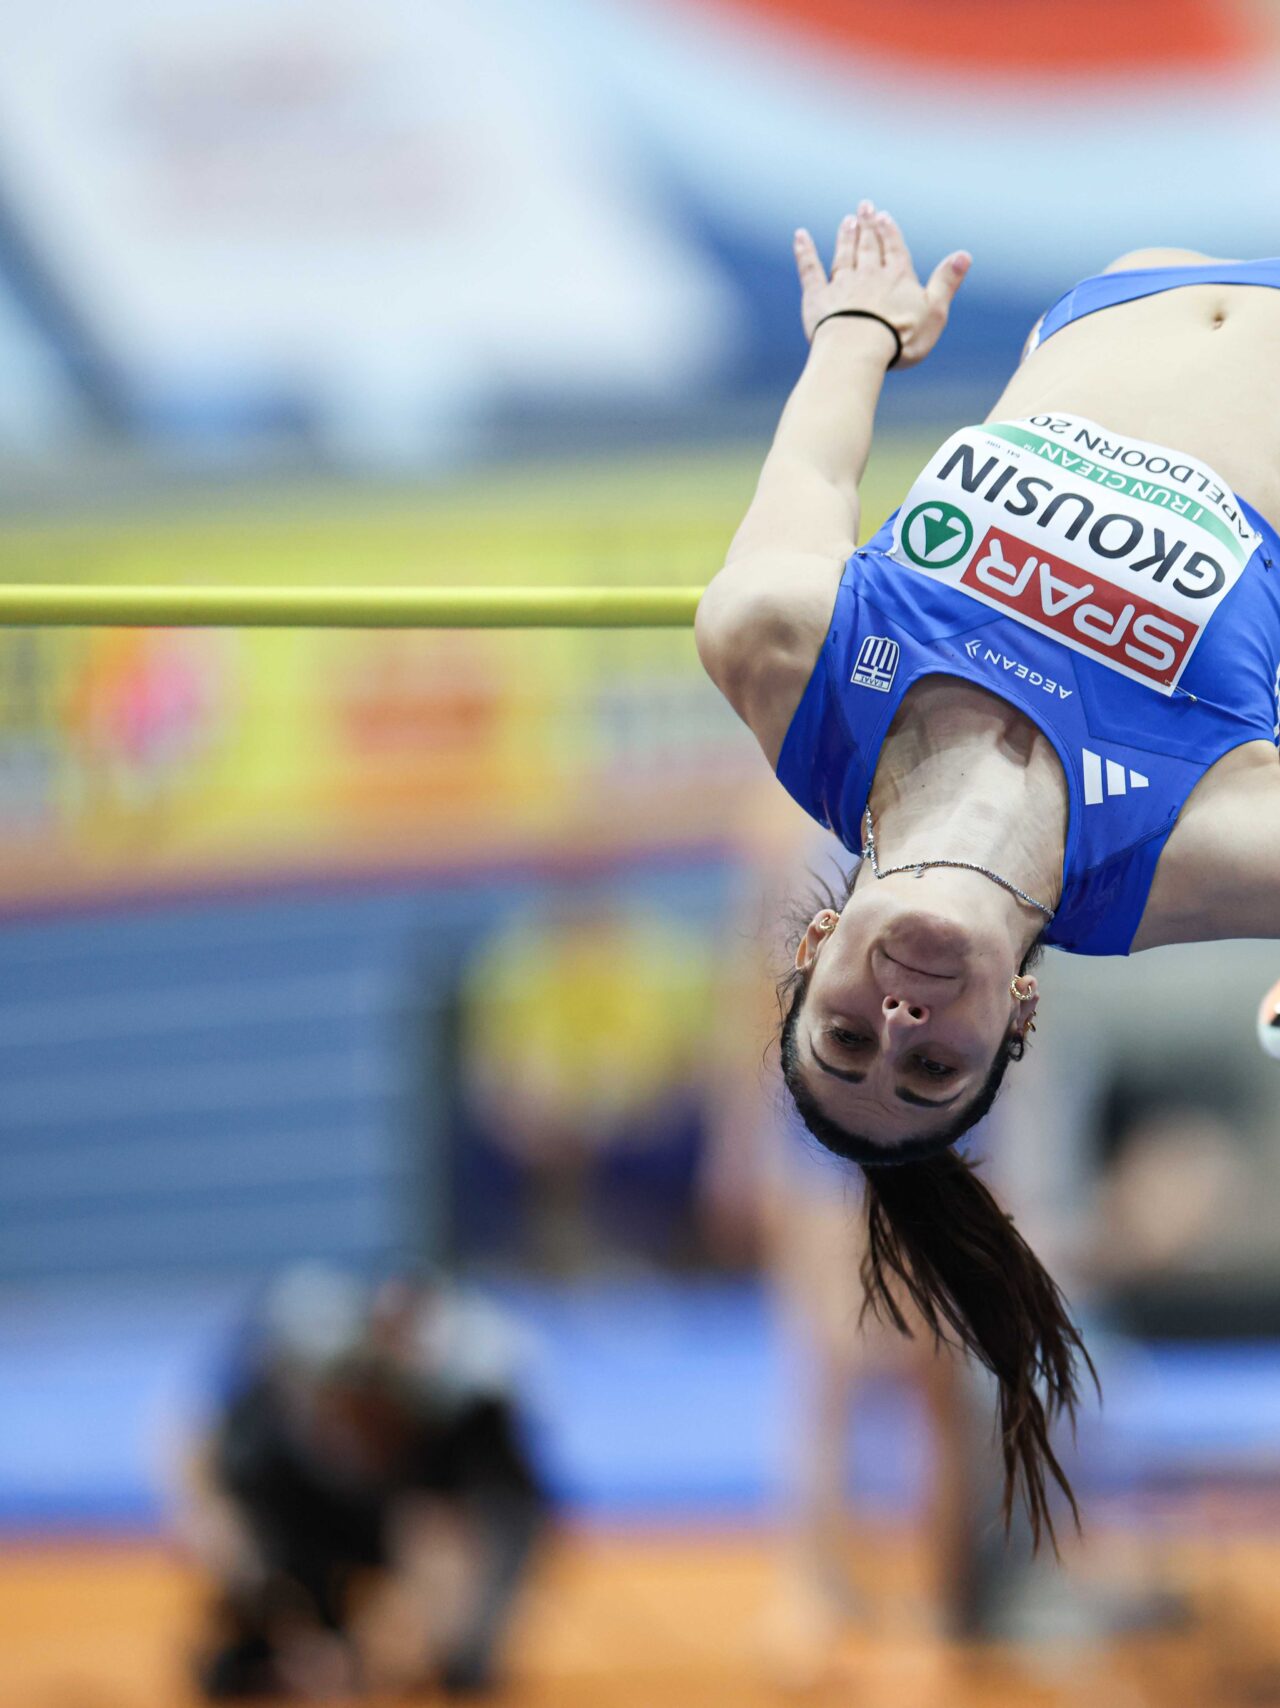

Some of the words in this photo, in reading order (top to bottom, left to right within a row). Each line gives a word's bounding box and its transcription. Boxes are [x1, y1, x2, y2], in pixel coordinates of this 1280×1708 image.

[936, 444, 1226, 599] GKOUSIN
[1074, 428, 1249, 539] APELDOORN
[1129, 479, 1191, 515] RUN
[1192, 507, 1204, 521] I
[975, 538, 1185, 671] SPAR
[984, 648, 1073, 699] AEGEAN
